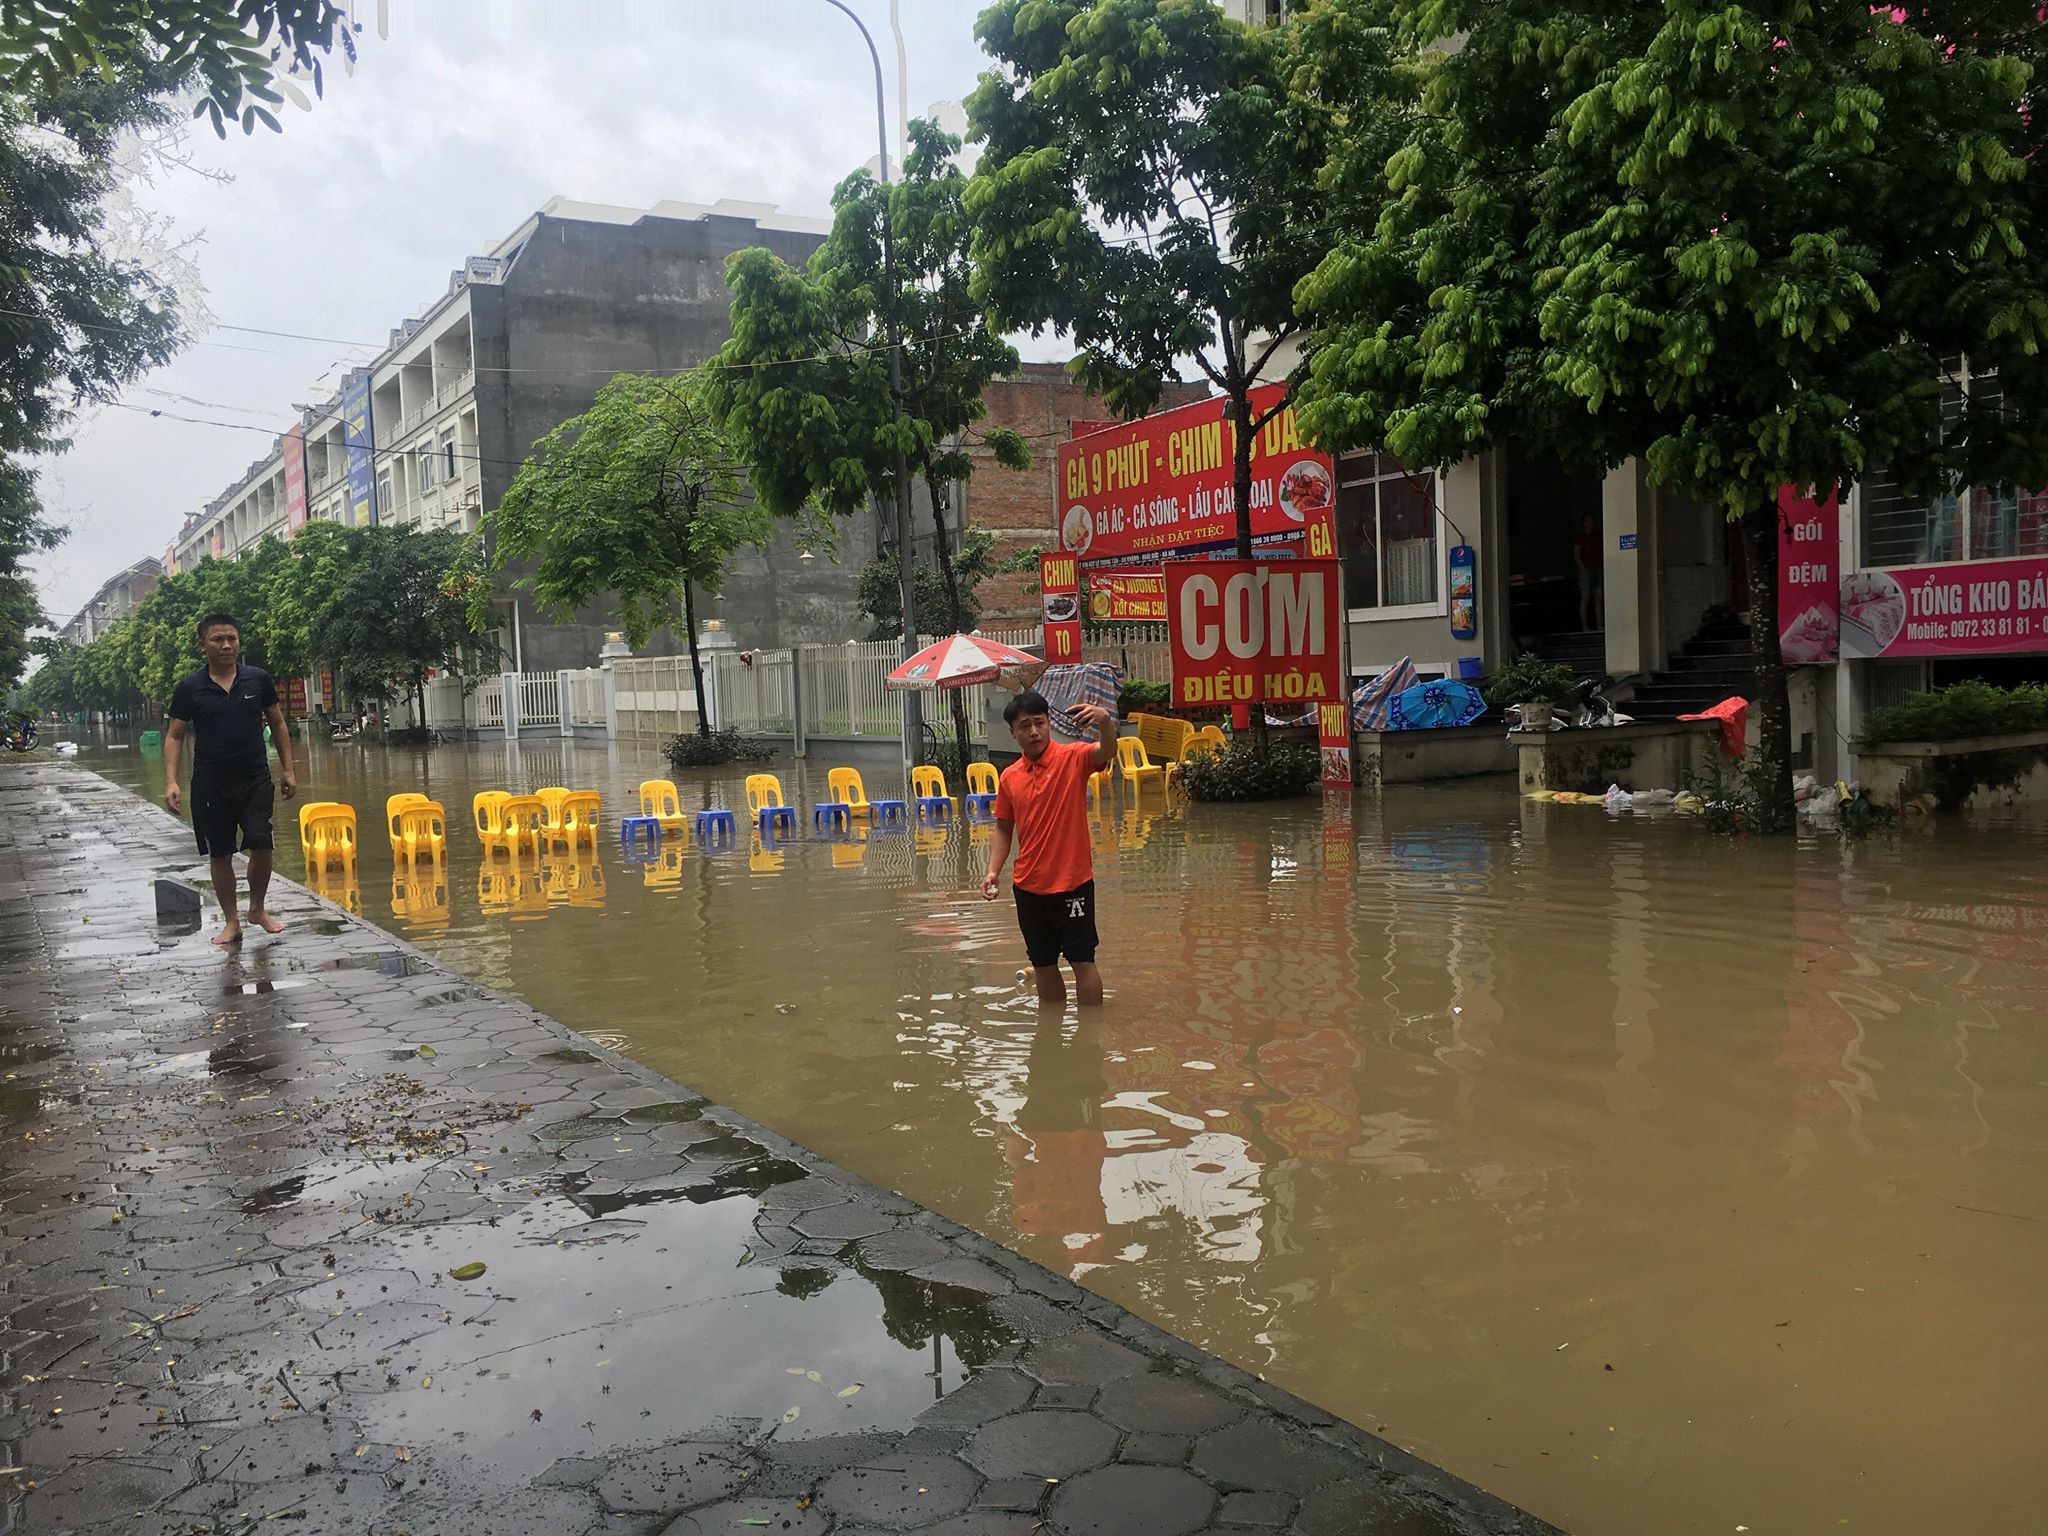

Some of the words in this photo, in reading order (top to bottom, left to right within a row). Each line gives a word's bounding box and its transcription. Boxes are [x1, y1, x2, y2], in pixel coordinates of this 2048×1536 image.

[1067, 448, 1088, 500] GÀ
[1091, 453, 1102, 495] 9
[1106, 433, 1149, 491] PHÚT
[1168, 421, 1222, 478] CHIM
[1096, 505, 1109, 535] GÀ
[1111, 503, 1124, 534] ÁC
[1133, 498, 1147, 529] CÁ
[1149, 495, 1179, 527] SÔNG
[1188, 481, 1211, 520] LẨU
[1248, 478, 1273, 513] OẠI
[1132, 533, 1165, 549] NHẬN
[1168, 528, 1193, 544] ĐẶT
[1194, 524, 1225, 539] TIỆC
[1310, 515, 1332, 557] GÀ
[1793, 516, 1823, 541] GỐI
[1044, 560, 1075, 587] CHIM
[1788, 561, 1827, 587] ĐỆM
[1910, 574, 1962, 616] TỔNG
[1969, 580, 2011, 613] KHO
[2017, 571, 2048, 610] BÁ
[1128, 601, 1149, 616] CHIM
[1180, 566, 1325, 661] CƠM
[1907, 621, 1948, 640] Mobile:
[1951, 619, 1979, 638] 0972
[1981, 618, 1996, 636] 33
[1999, 617, 2012, 636] 81
[2016, 616, 2030, 635] 81
[1056, 629, 1070, 657] TO
[1183, 666, 1253, 702] ĐIỀU
[1264, 667, 1327, 699] HÒA
